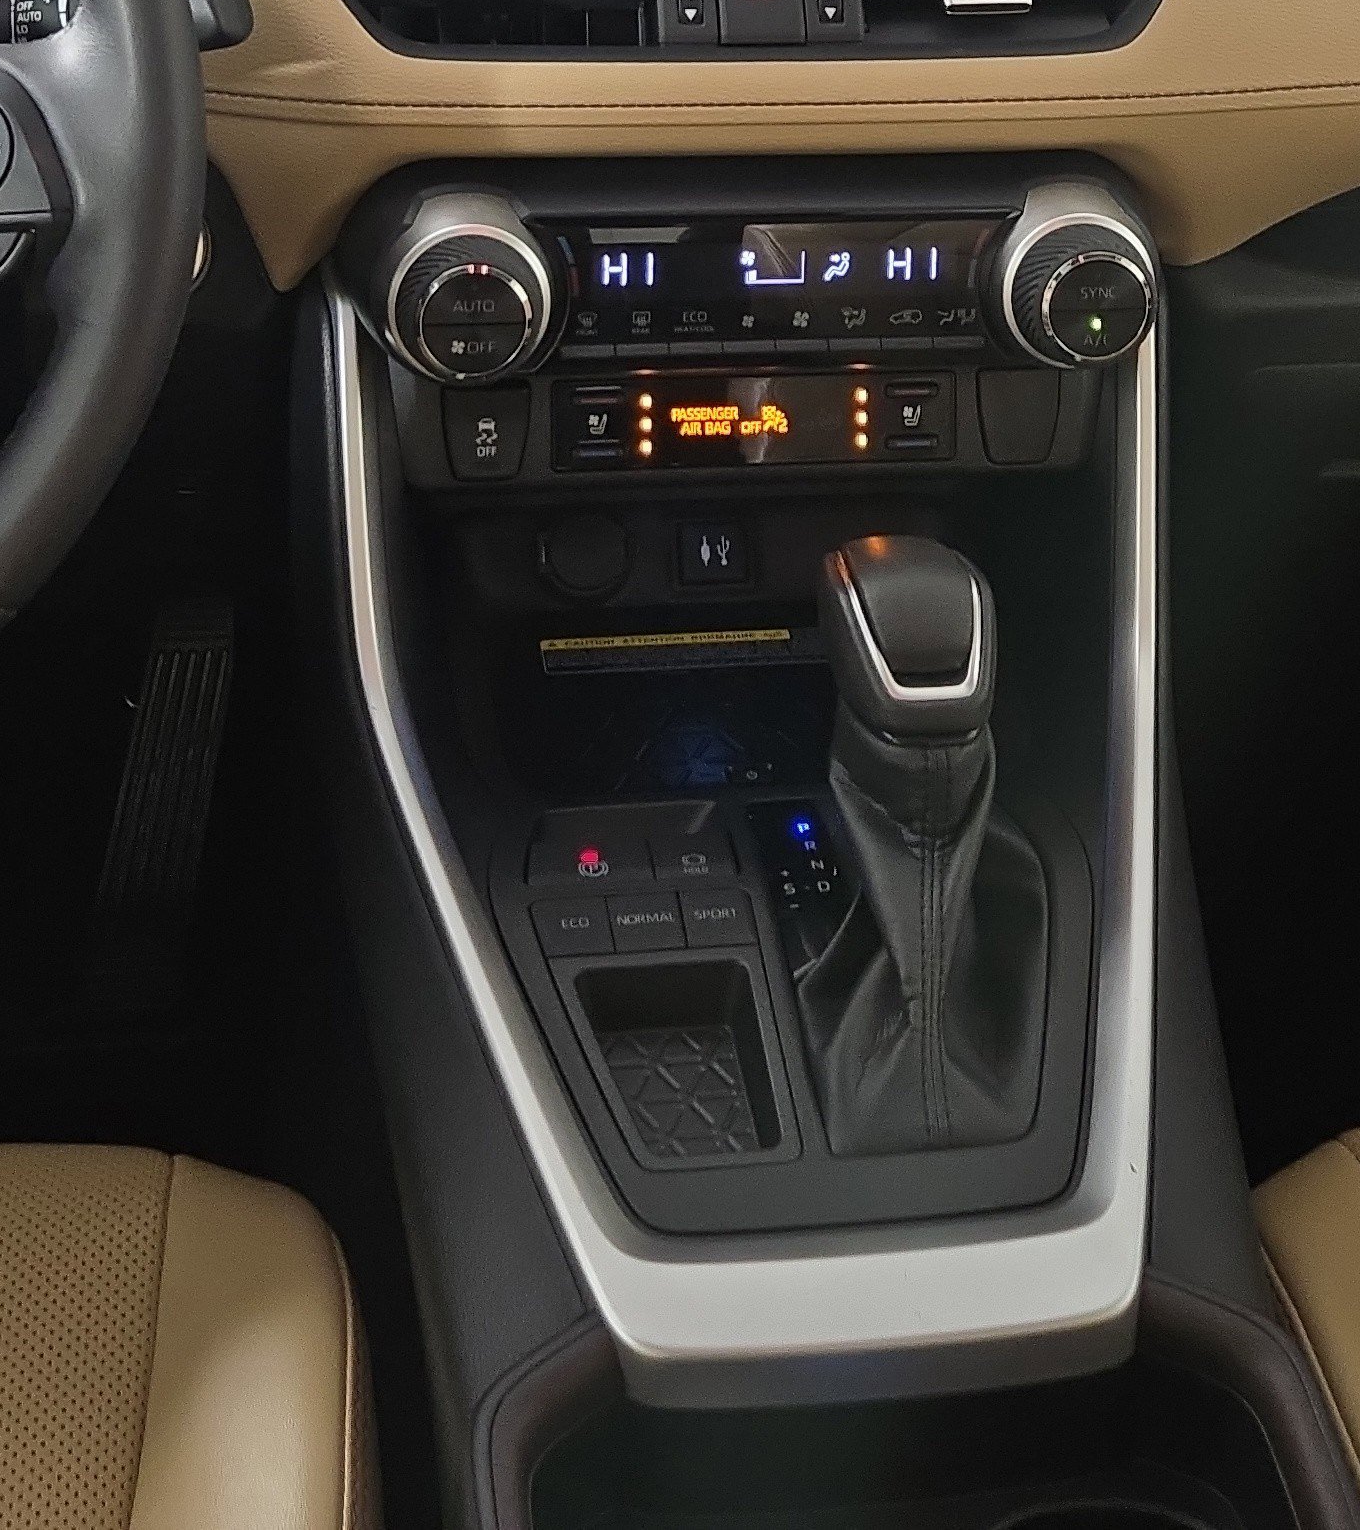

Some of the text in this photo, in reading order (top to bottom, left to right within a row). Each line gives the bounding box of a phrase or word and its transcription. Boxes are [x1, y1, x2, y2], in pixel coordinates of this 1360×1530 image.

[16, 0, 34, 12] OFF
[16, 10, 43, 23] AUTO
[1080, 286, 1116, 299] SYNC
[453, 299, 495, 314] AUTO
[683, 311, 708, 323] ECO
[467, 341, 495, 354] OFF
[671, 406, 739, 421] PASSENGER
[680, 420, 761, 436] AIR BAG OFF
[476, 446, 497, 458] OFF
[811, 859, 825, 870] N
[784, 880, 830, 895] S D
[616, 912, 677, 926] NORMAL
[694, 906, 737, 920] SPORT
[561, 917, 590, 929] ECO
